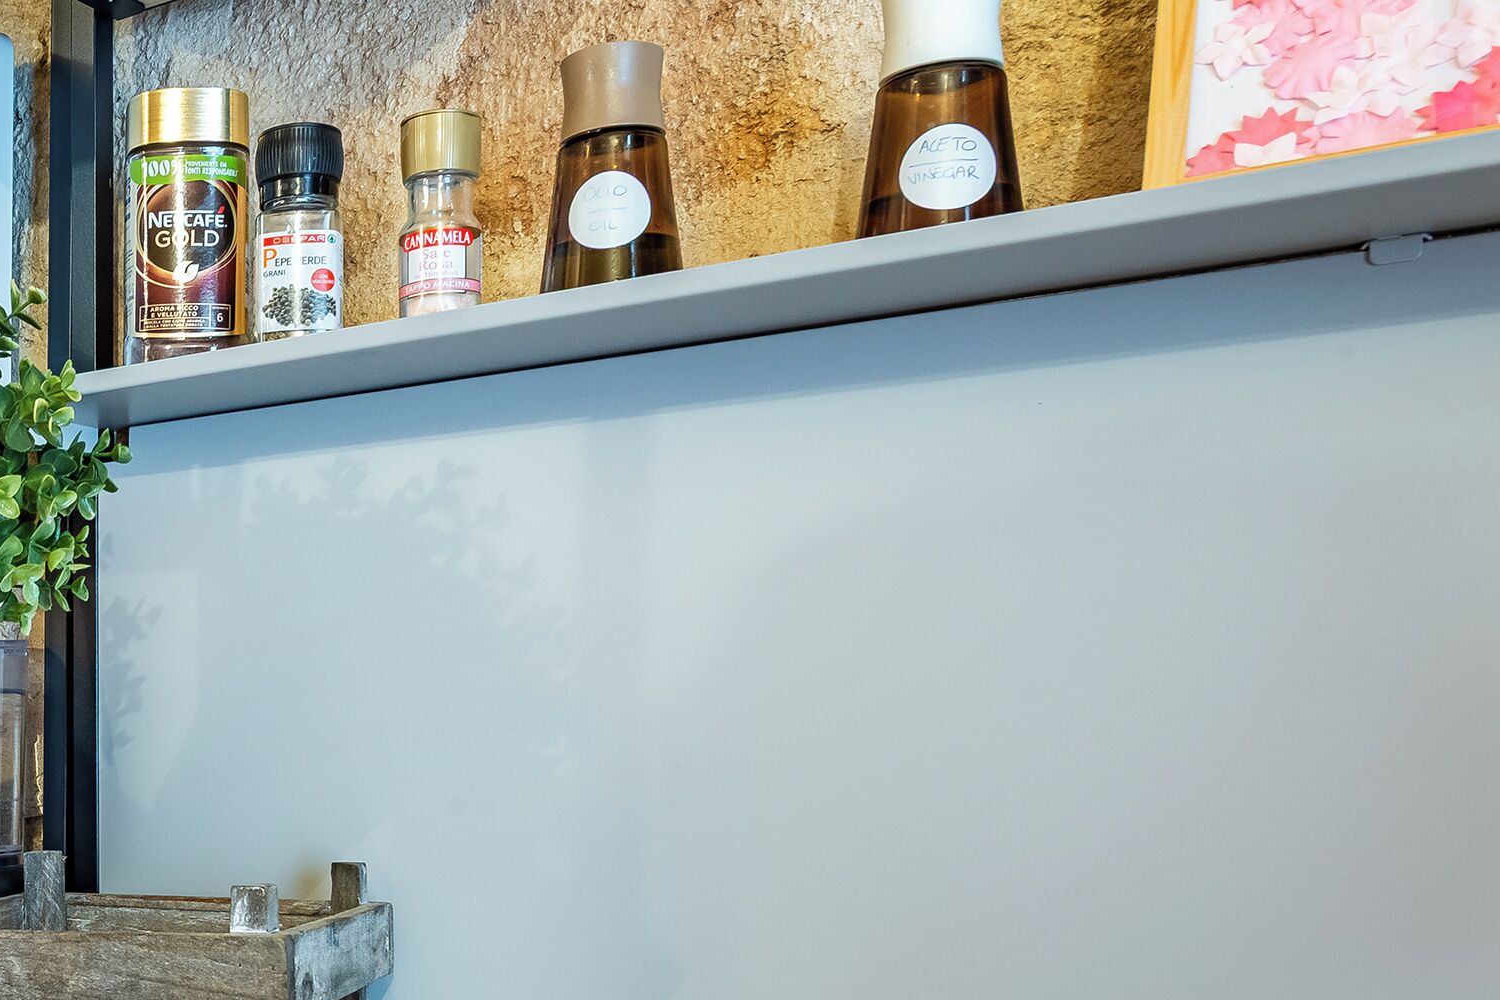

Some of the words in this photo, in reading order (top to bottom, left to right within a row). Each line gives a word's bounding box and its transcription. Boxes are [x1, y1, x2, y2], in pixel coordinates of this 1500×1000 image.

[918, 136, 978, 154] ACETO
[907, 165, 980, 185] VINEGAR
[583, 185, 627, 201] OLIO
[589, 219, 618, 232] OIL
[155, 229, 220, 248] GOLD
[404, 230, 471, 251] CANNAMELA
[263, 248, 292, 268] PEPE
[296, 256, 327, 265] ERDE
[263, 269, 286, 278] GRANI
[216, 312, 224, 323] 6
